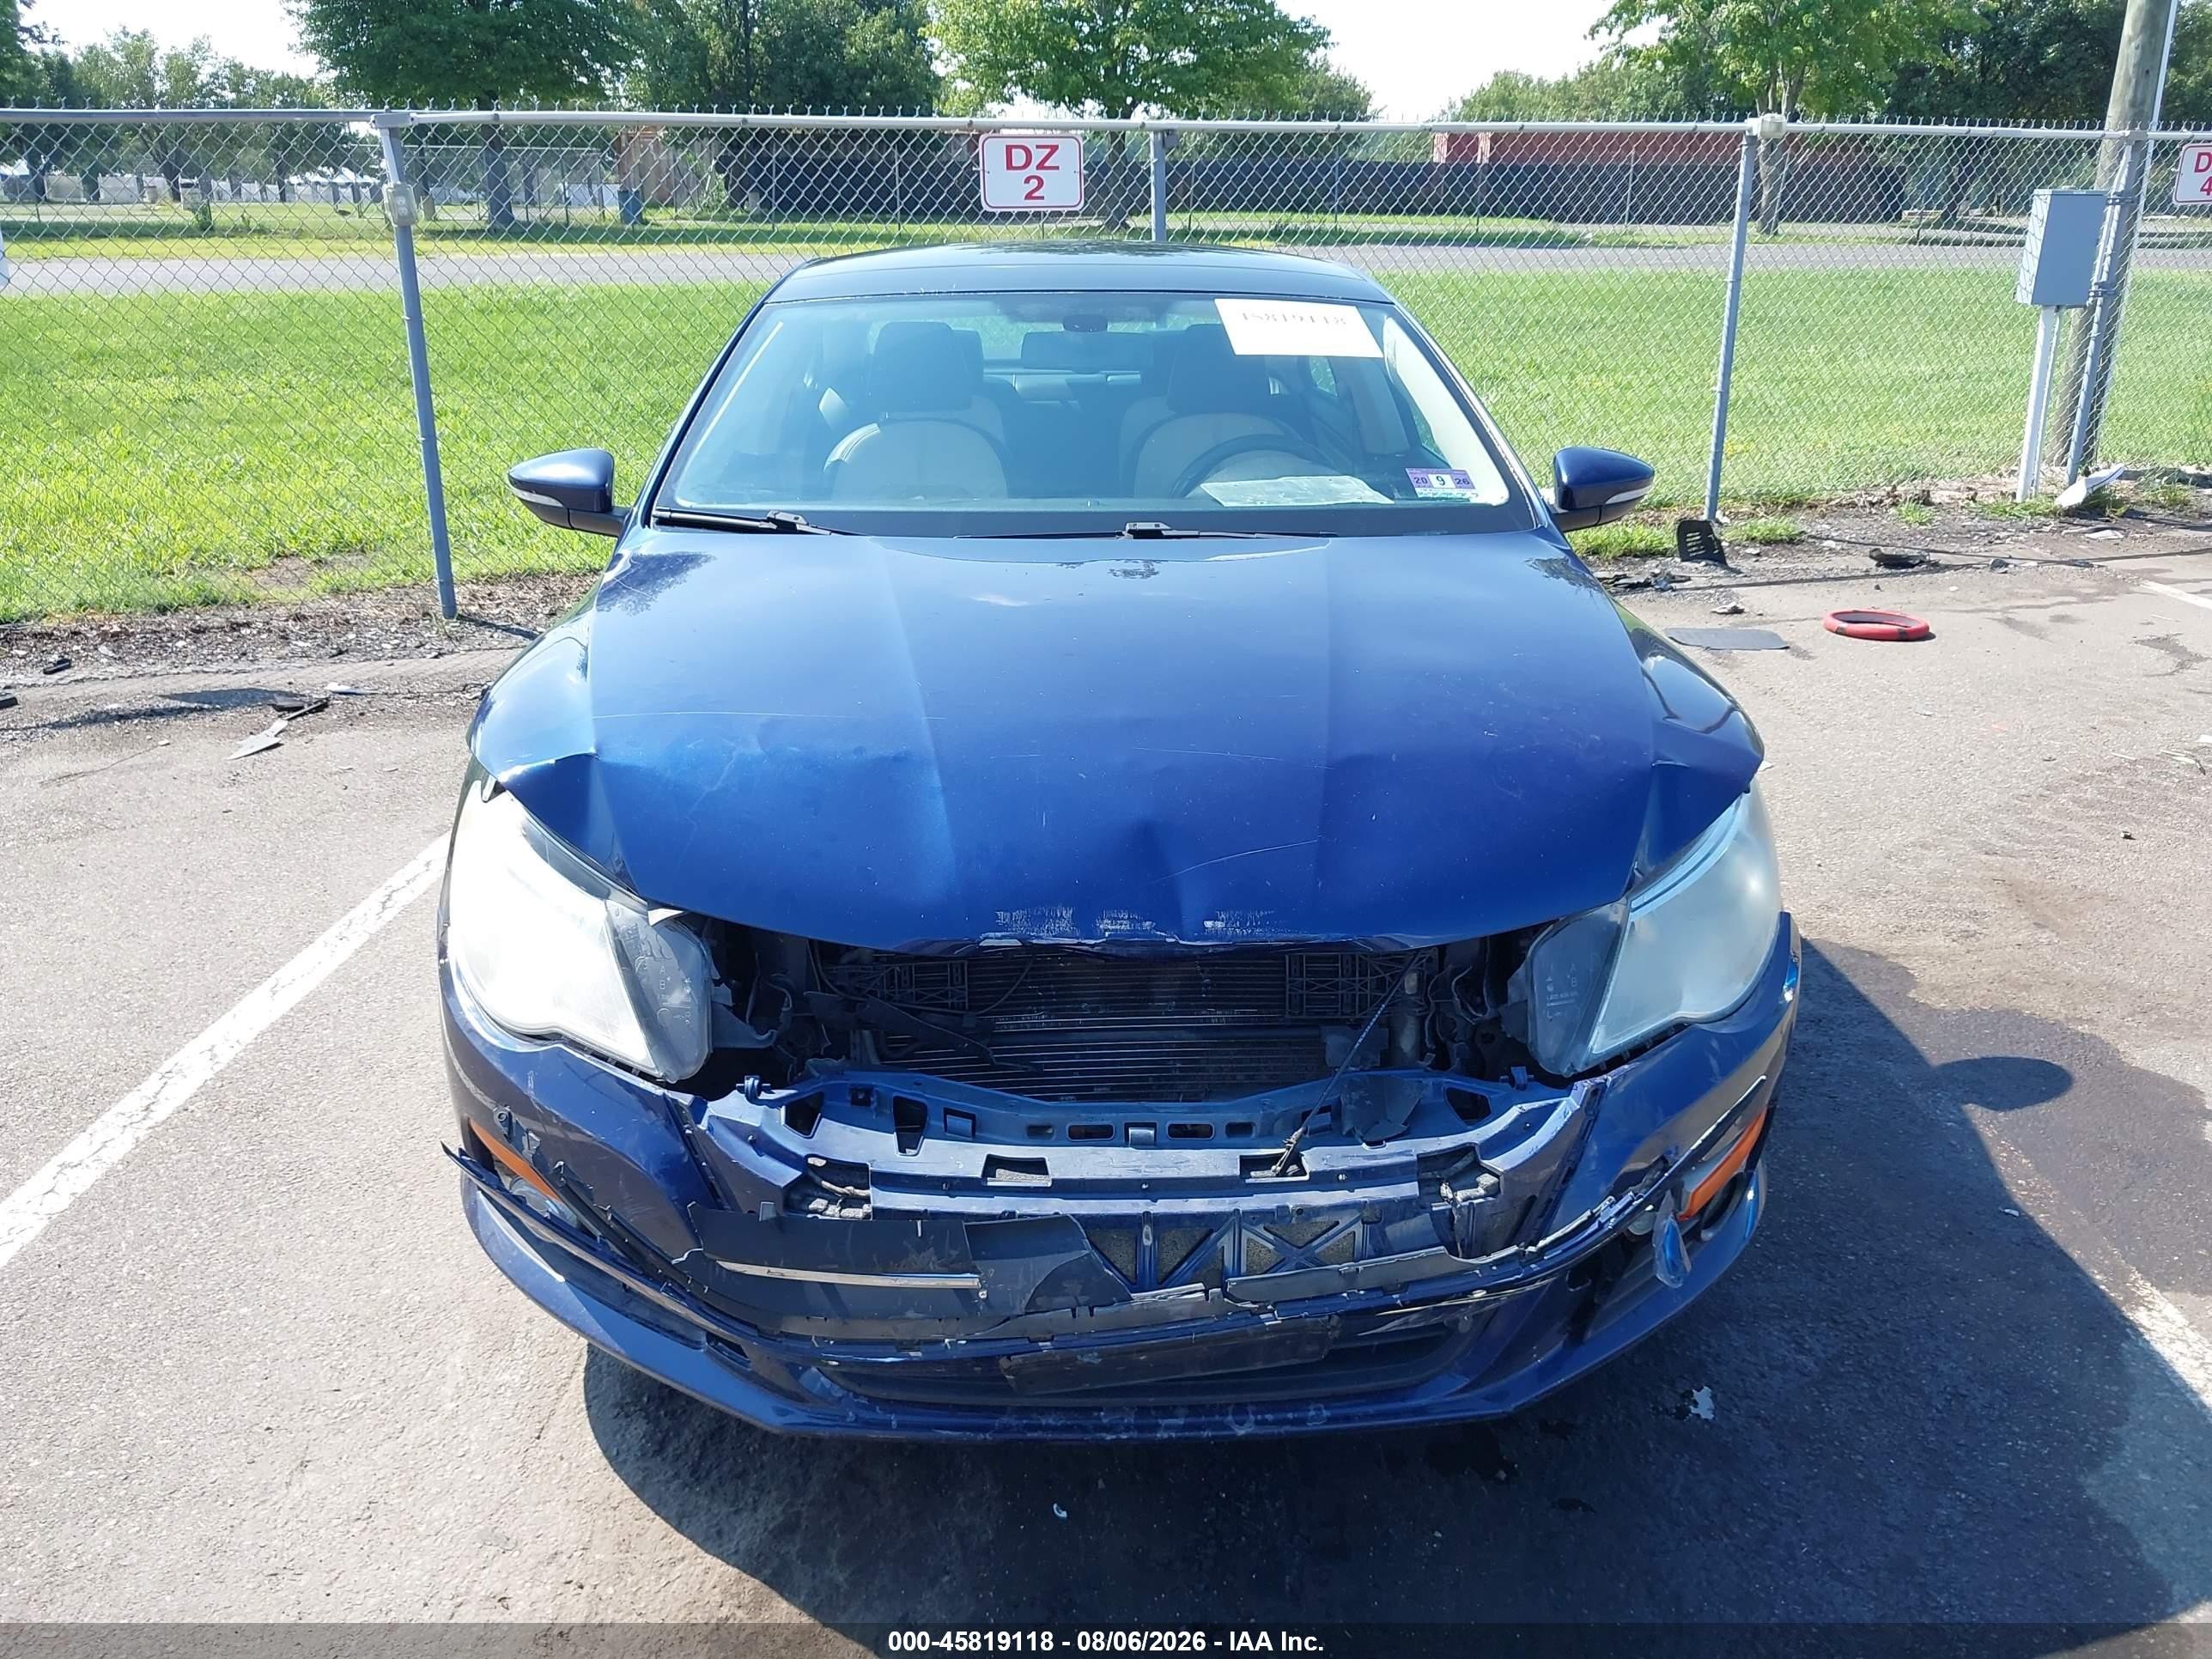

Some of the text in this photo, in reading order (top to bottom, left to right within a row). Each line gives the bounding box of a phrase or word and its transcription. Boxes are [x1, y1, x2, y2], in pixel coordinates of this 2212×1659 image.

[1005, 144, 1060, 171] DZ
[1024, 175, 1045, 201] 2
[1436, 475, 1446, 486] 9
